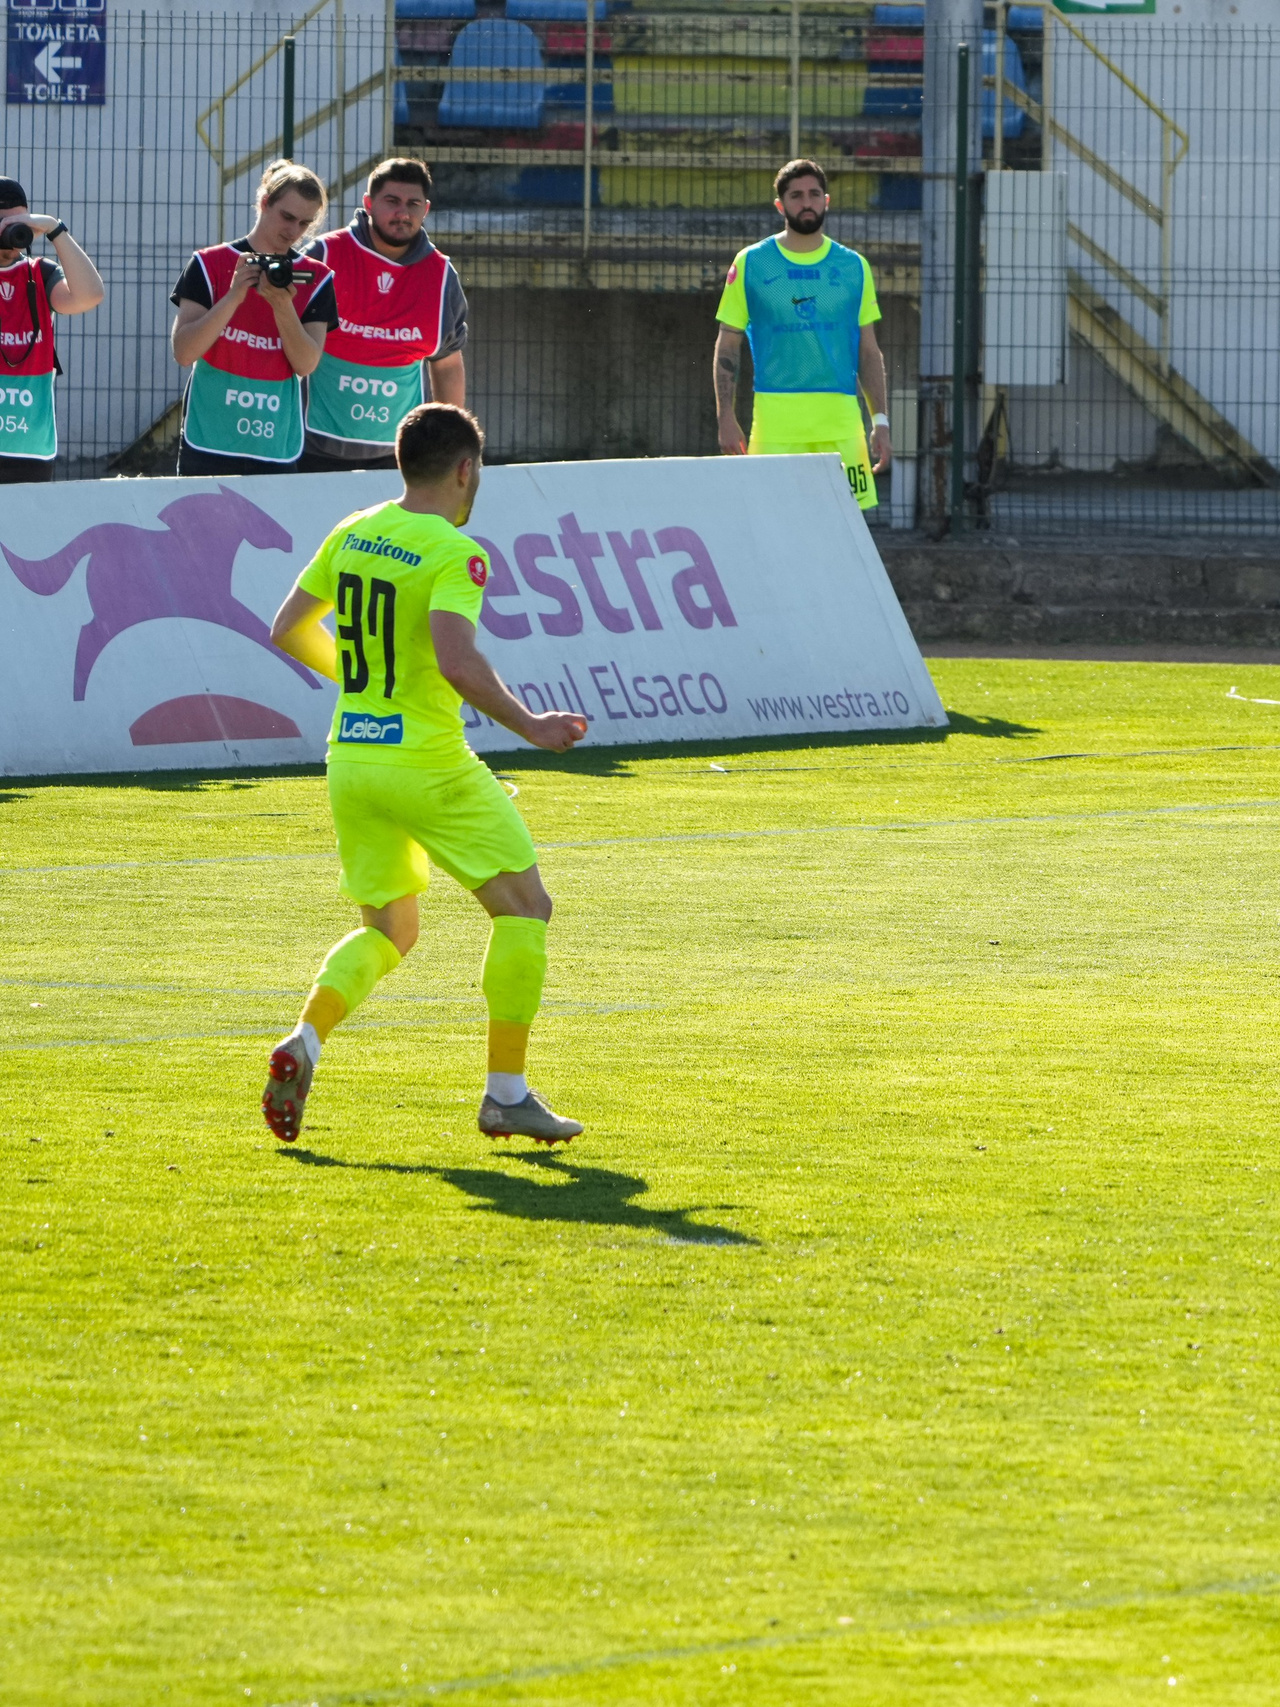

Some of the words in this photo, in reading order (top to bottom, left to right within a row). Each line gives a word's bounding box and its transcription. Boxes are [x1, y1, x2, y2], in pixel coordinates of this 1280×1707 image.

[15, 23, 100, 41] TOALETA
[24, 84, 88, 101] TOILET
[338, 375, 398, 397] FOTO
[0, 388, 33, 407] TO
[225, 389, 280, 412] FOTO
[350, 403, 390, 423] 043
[236, 418, 275, 438] 038
[847, 464, 867, 494] 95
[342, 533, 422, 567] Panifcom
[470, 511, 739, 640] estra
[338, 572, 397, 699] 37
[588, 661, 728, 720] Elsaco
[747, 687, 910, 722] www.vestra.ro
